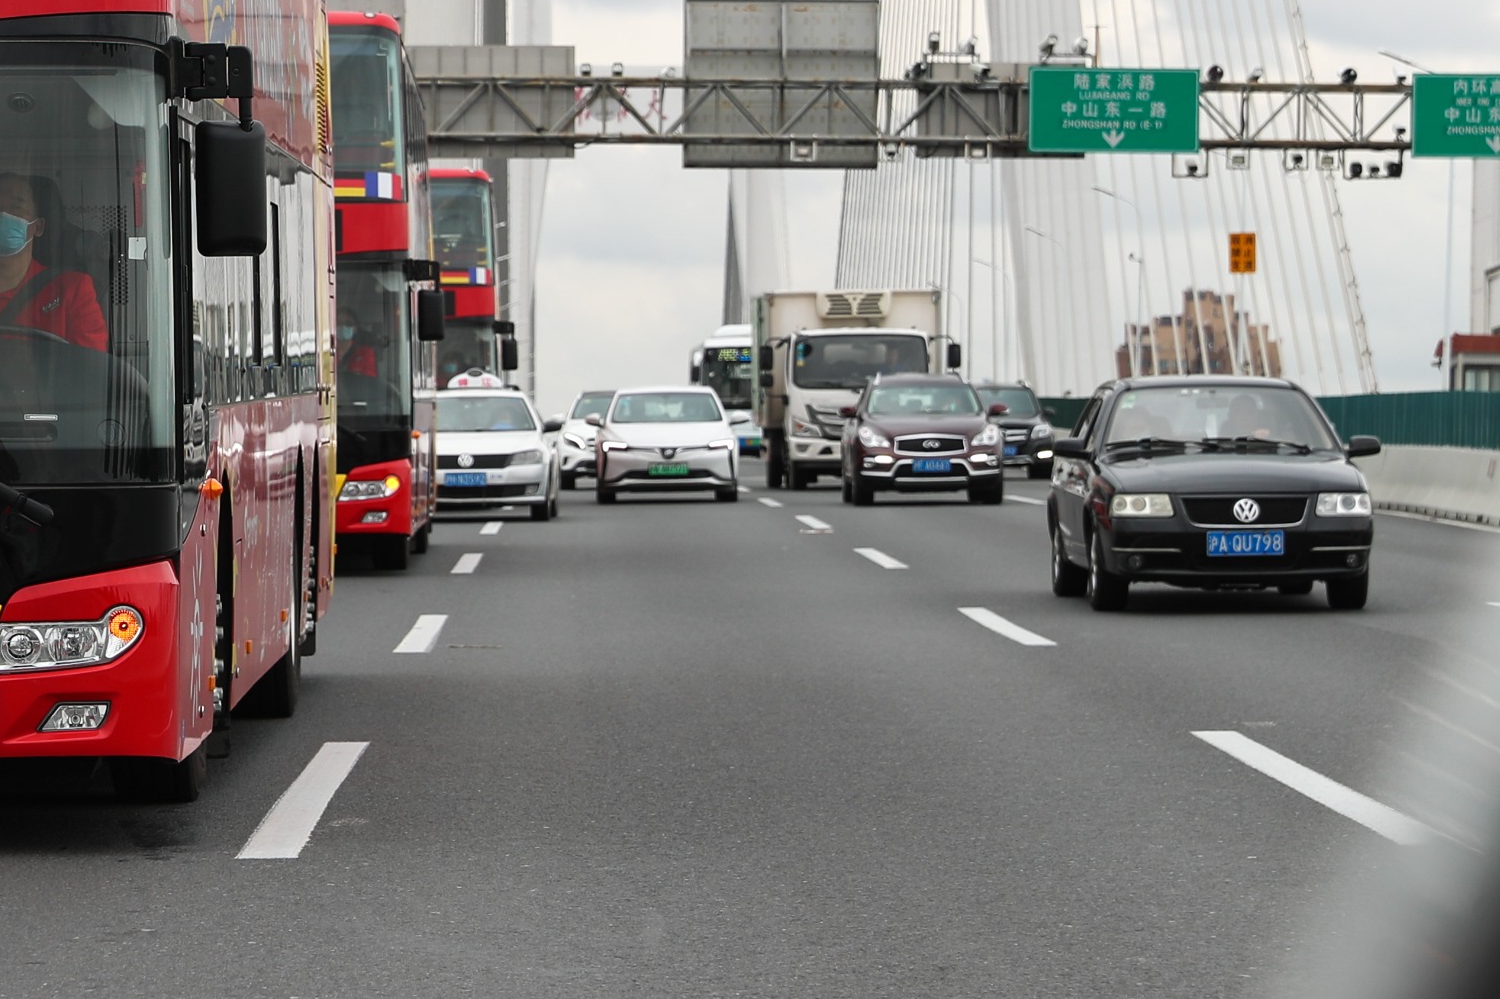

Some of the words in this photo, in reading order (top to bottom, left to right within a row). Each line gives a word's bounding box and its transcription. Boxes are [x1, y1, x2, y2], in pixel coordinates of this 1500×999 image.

[1074, 73, 1155, 91] 陆家浜路
[1079, 91, 1131, 101] LUJIABANG
[1135, 92, 1150, 101] RD
[1061, 101, 1167, 118] 中山东一路
[1062, 119, 1120, 130] ZHONGSHAN
[1123, 120, 1136, 130] RD
